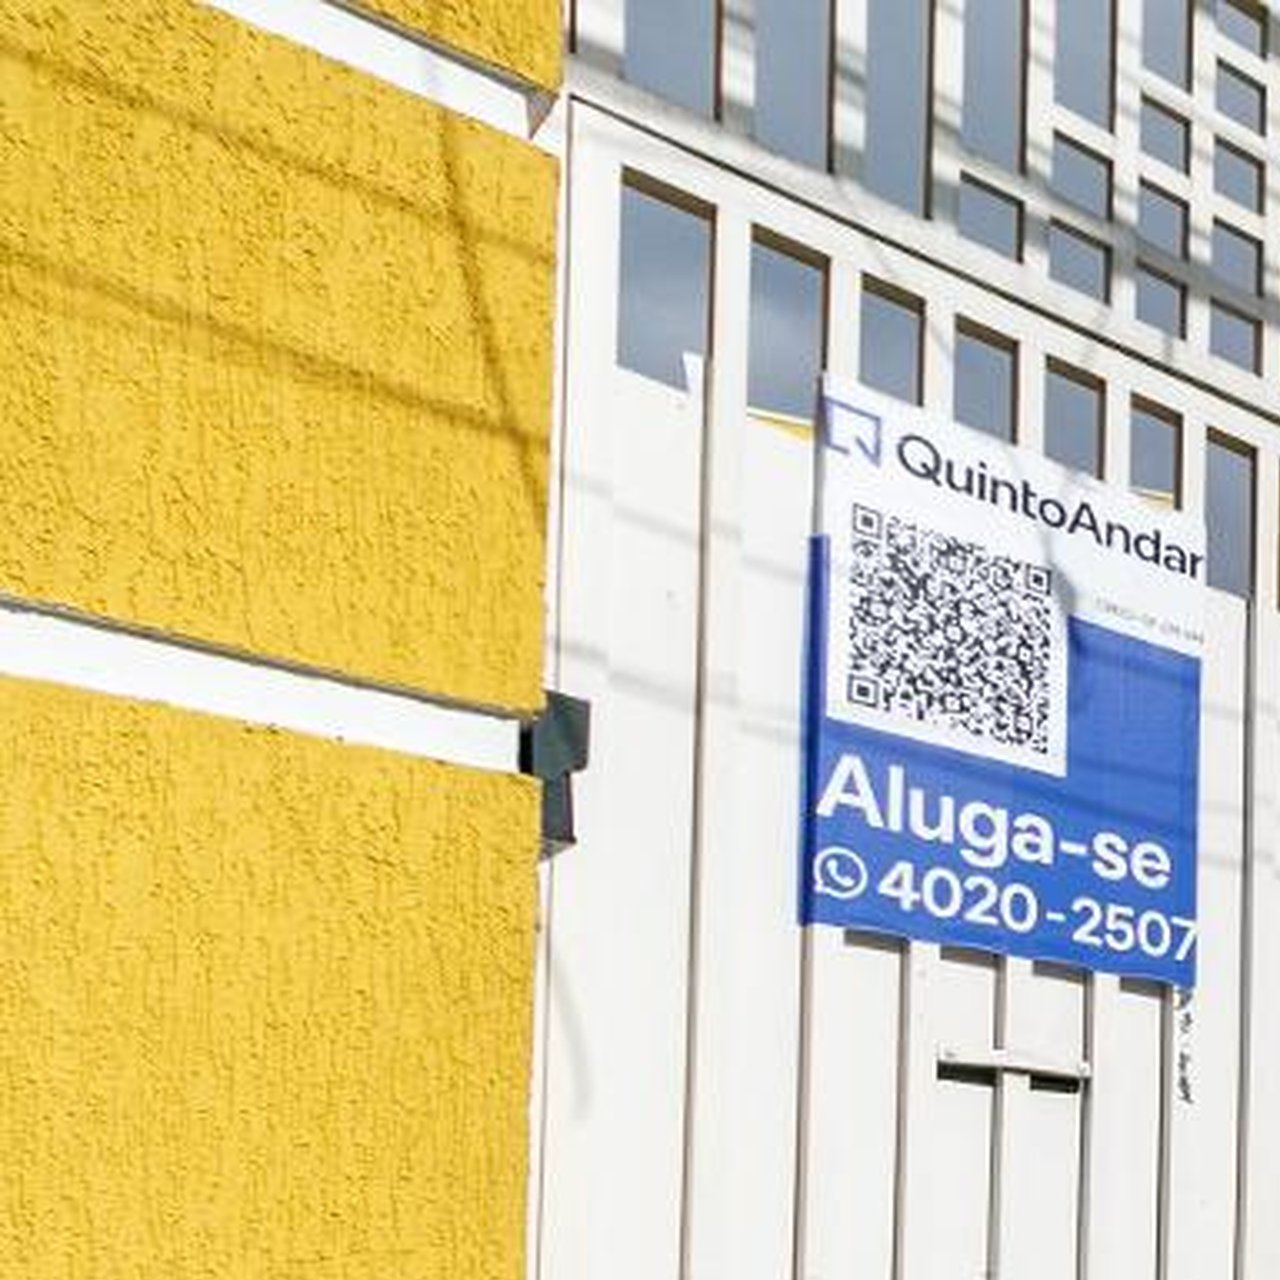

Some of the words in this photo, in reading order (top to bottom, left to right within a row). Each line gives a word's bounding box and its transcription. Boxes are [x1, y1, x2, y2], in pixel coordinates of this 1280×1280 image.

[896, 434, 1205, 579] QuintoAndar
[815, 753, 1171, 889] Aluga-se
[877, 861, 1198, 962] 4020-2507
